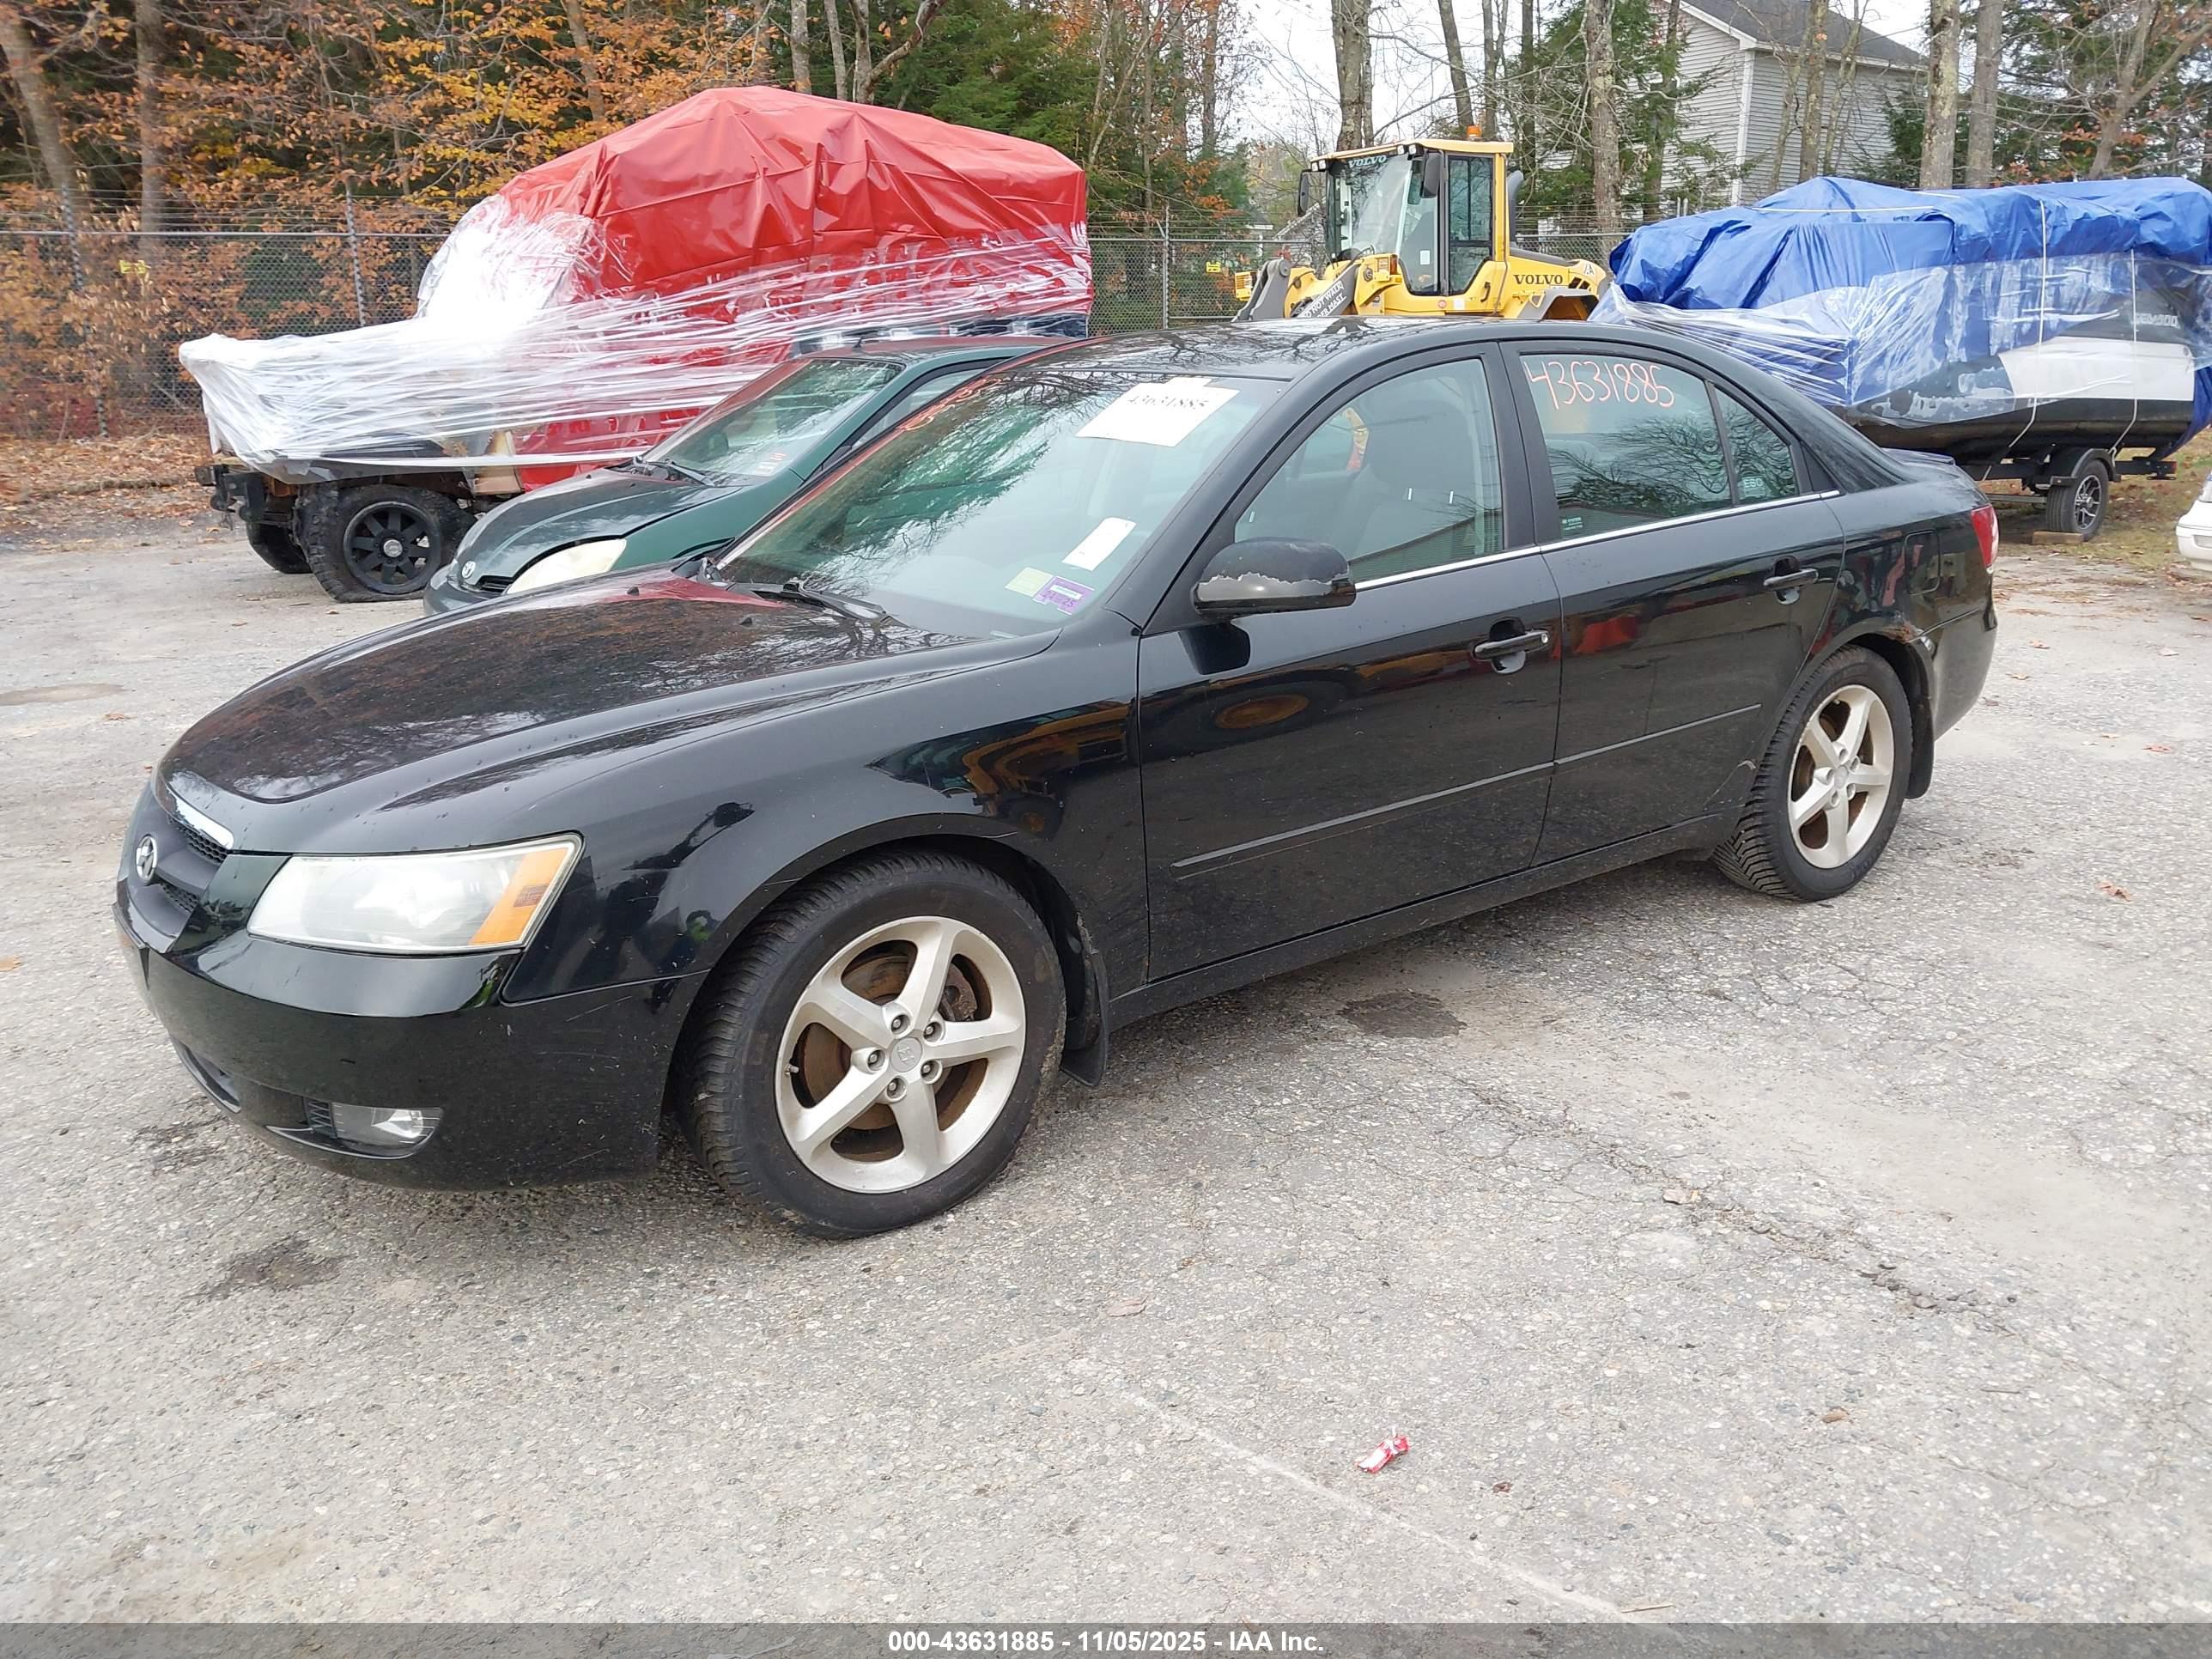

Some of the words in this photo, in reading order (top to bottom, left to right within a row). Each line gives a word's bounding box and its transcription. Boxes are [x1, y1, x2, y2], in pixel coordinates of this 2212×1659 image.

[1348, 155, 1387, 168] VOLVO
[1513, 274, 1563, 285] VOLVO
[1311, 297, 1325, 313] NOT
[1325, 281, 1345, 301] WALK
[1523, 361, 1674, 410] 43631885
